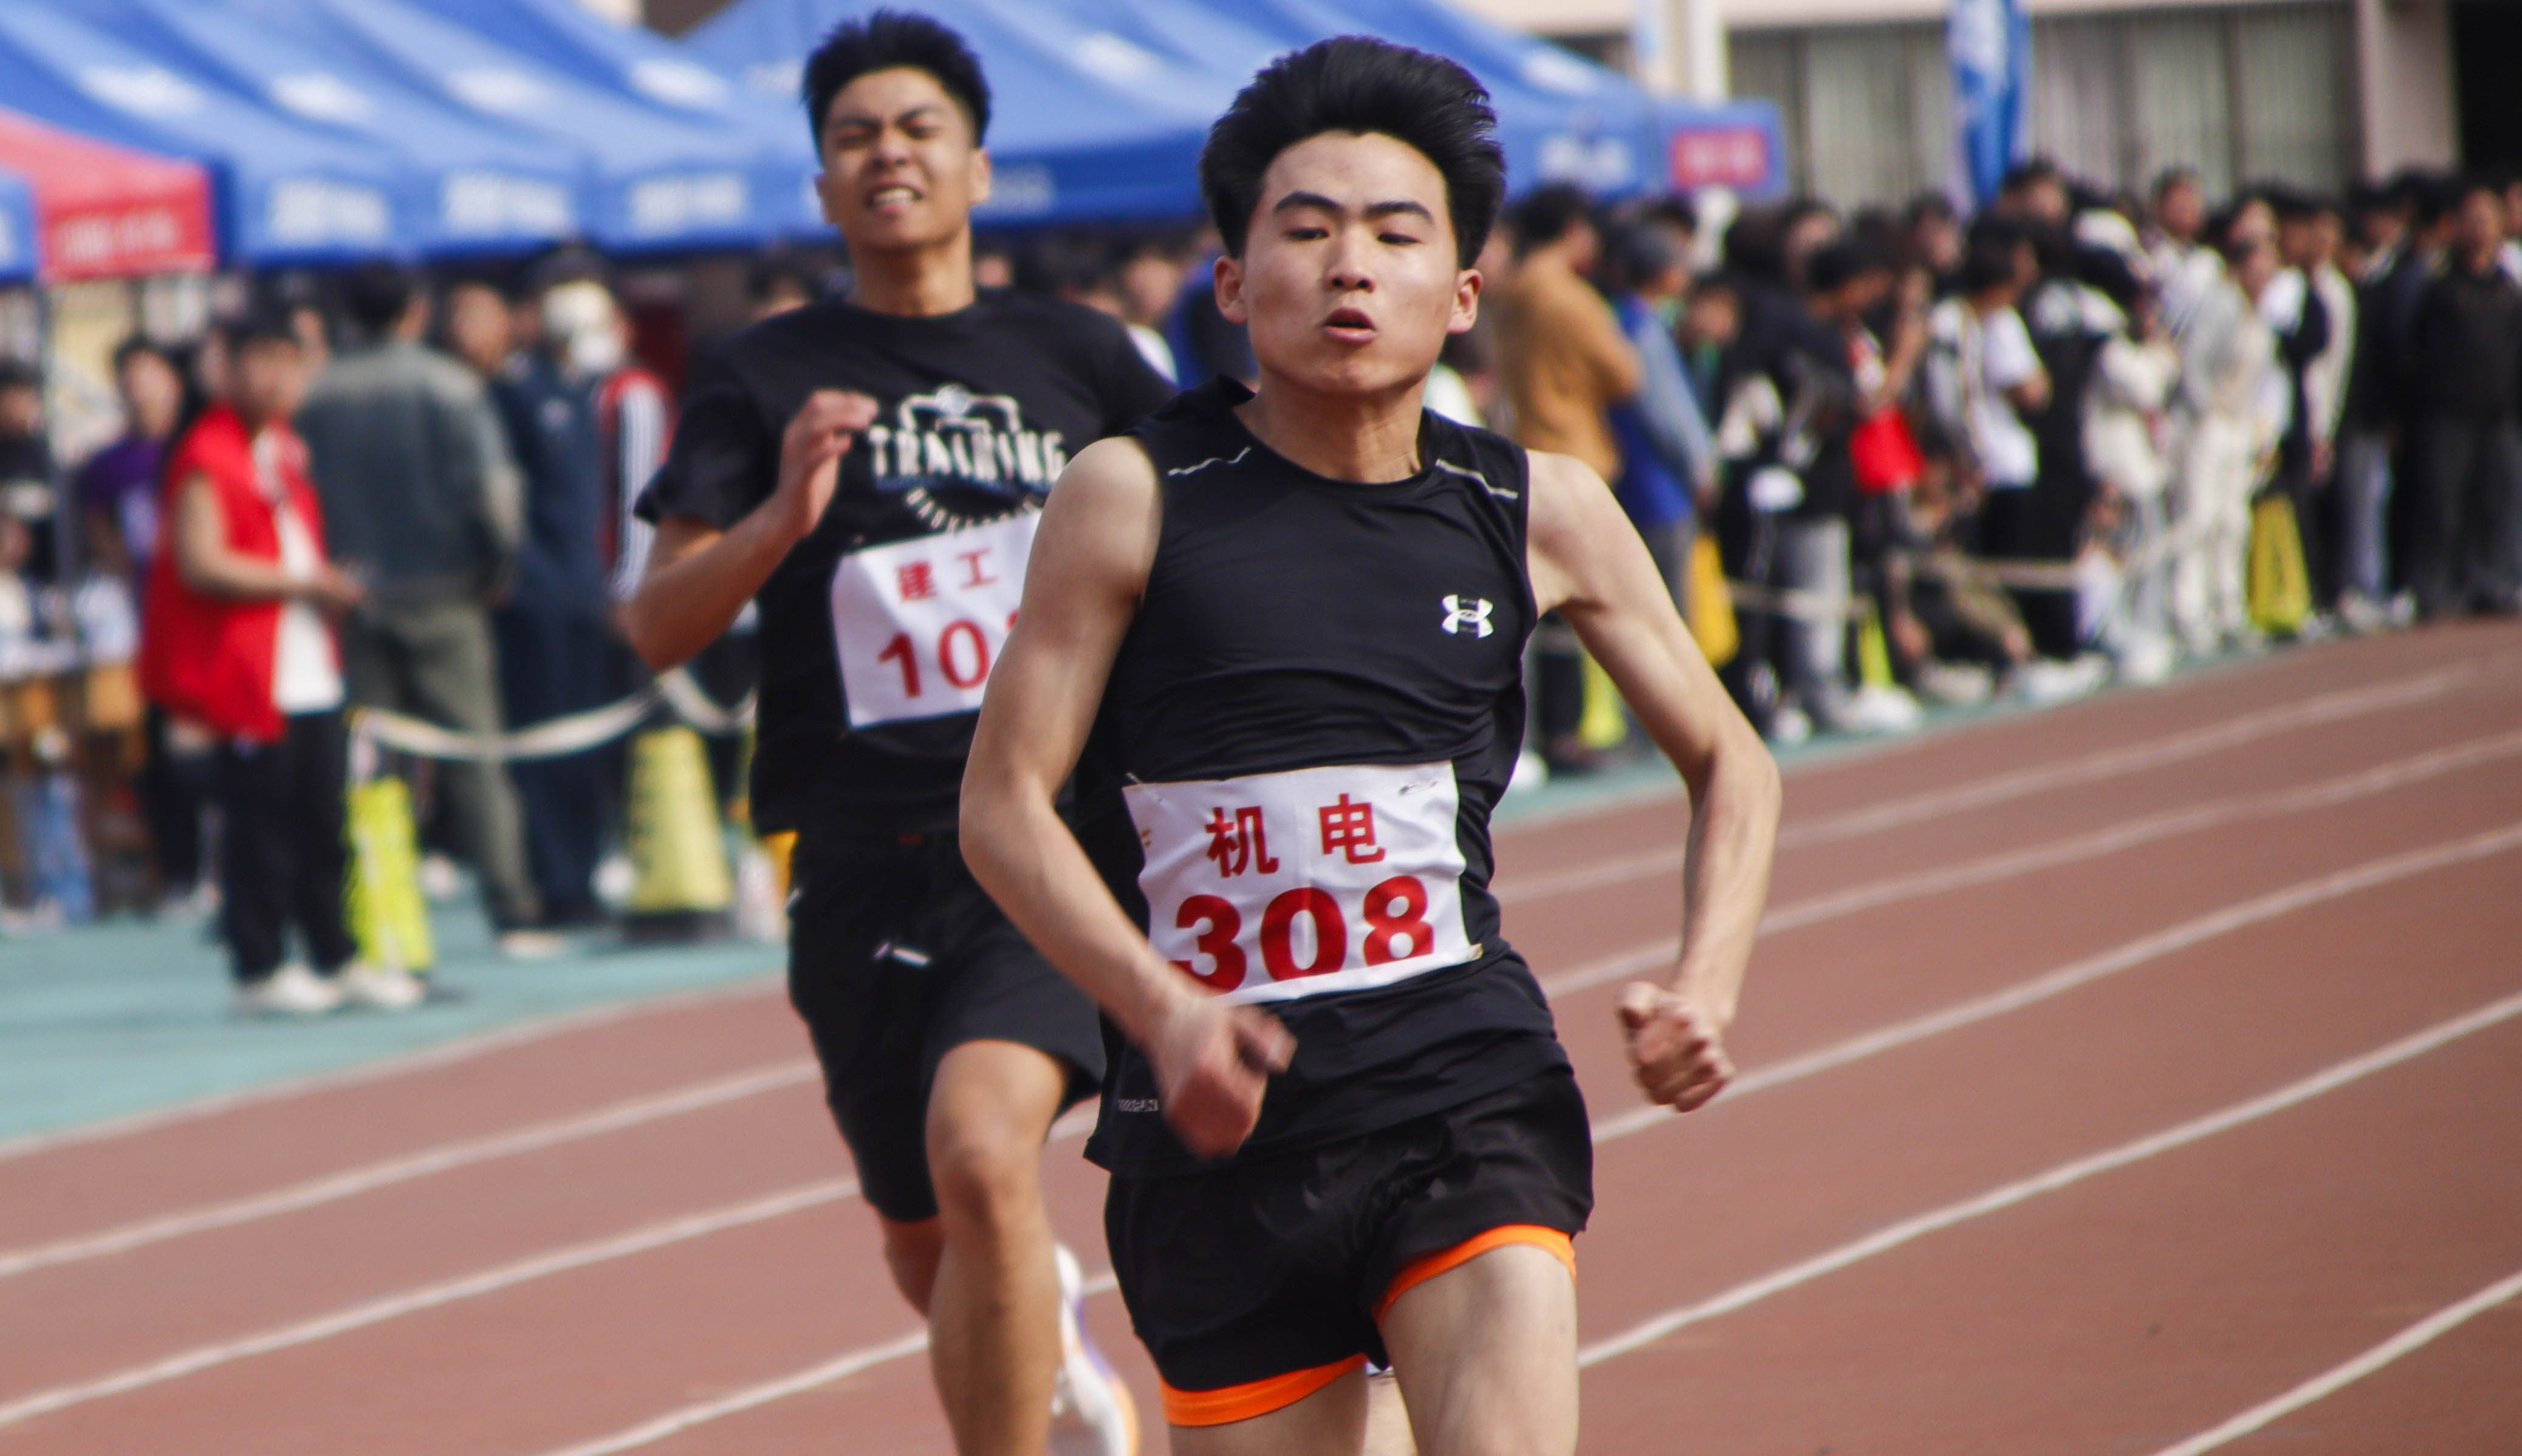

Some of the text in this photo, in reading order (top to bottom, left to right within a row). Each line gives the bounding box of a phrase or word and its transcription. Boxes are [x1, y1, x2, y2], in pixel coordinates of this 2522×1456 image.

[896, 548, 998, 601] 建工
[878, 609, 1019, 699] 10
[1205, 793, 1385, 878] 机电
[1167, 875, 1435, 995] 308
